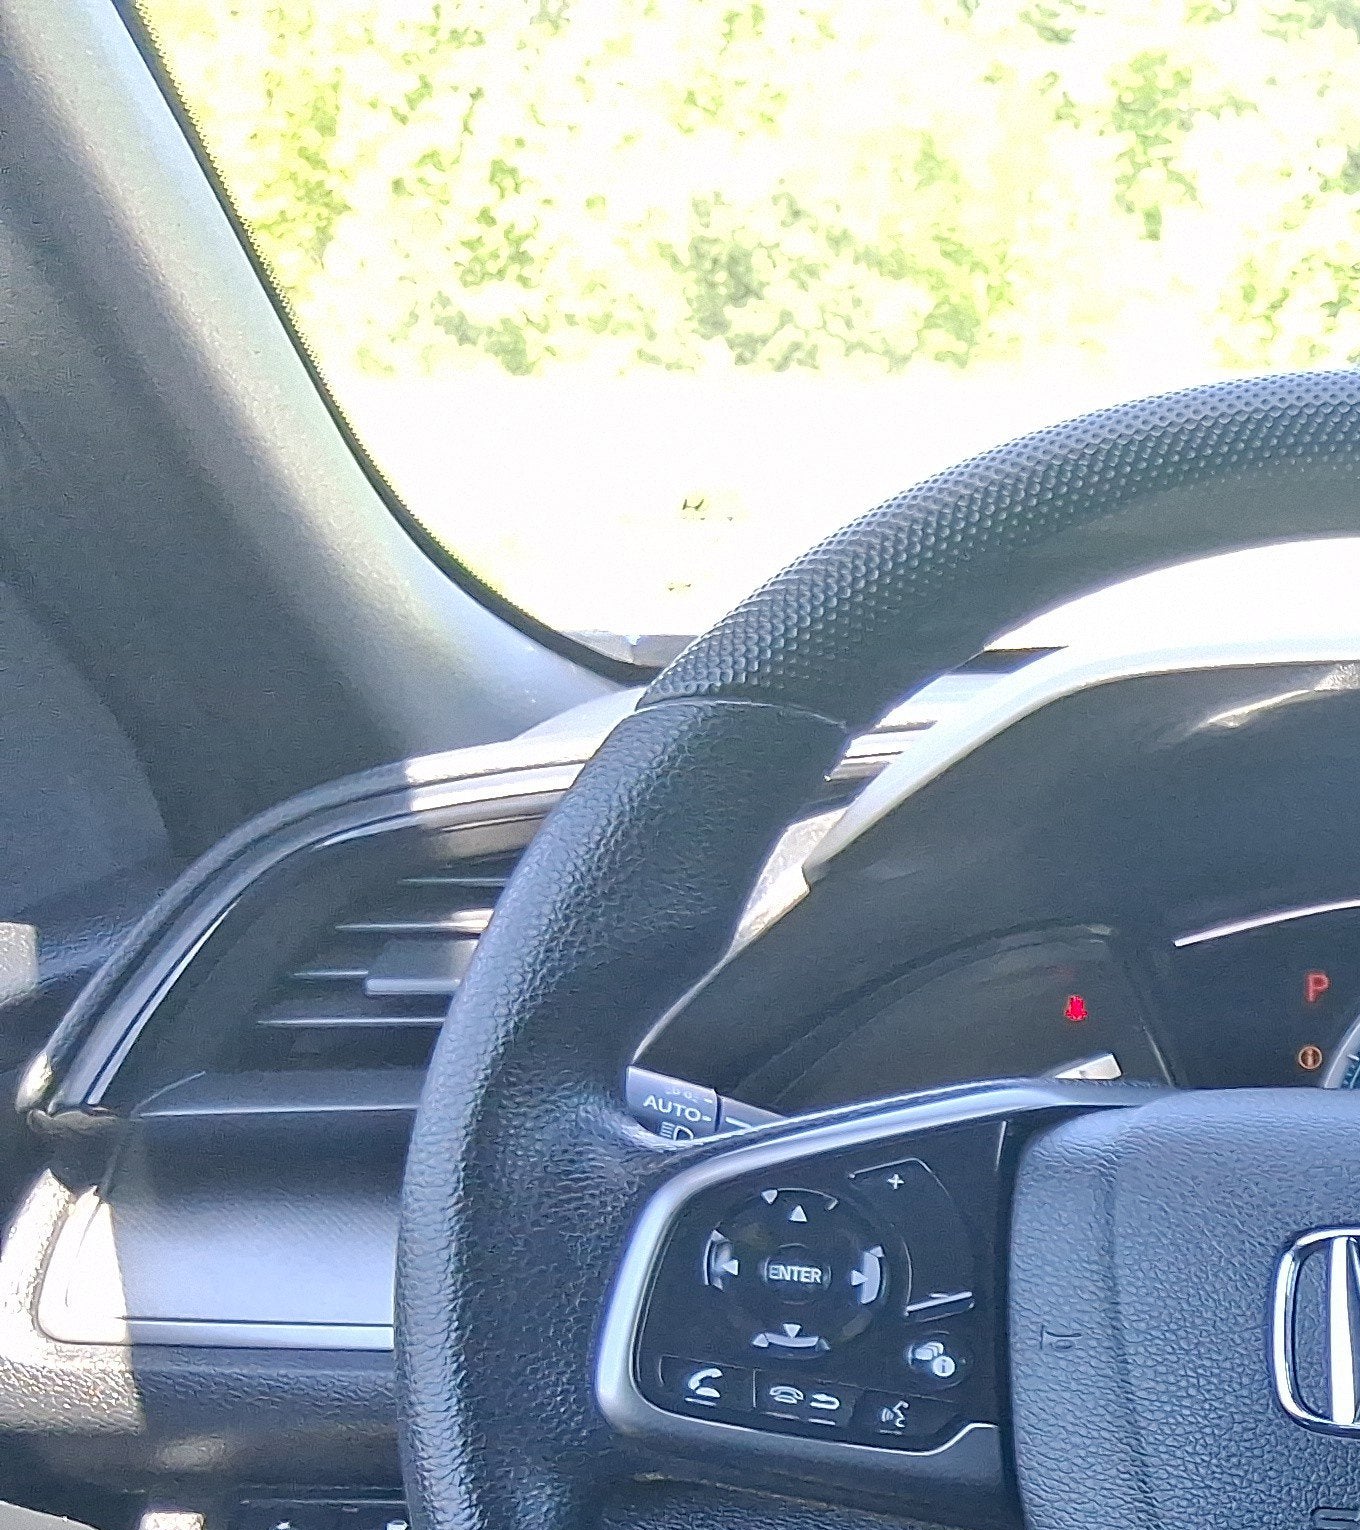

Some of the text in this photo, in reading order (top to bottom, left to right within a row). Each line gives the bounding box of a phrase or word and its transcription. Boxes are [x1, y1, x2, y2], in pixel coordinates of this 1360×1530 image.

[1306, 971, 1331, 1002] P
[643, 1094, 702, 1122] AUTO
[768, 1264, 822, 1285] ENTER
